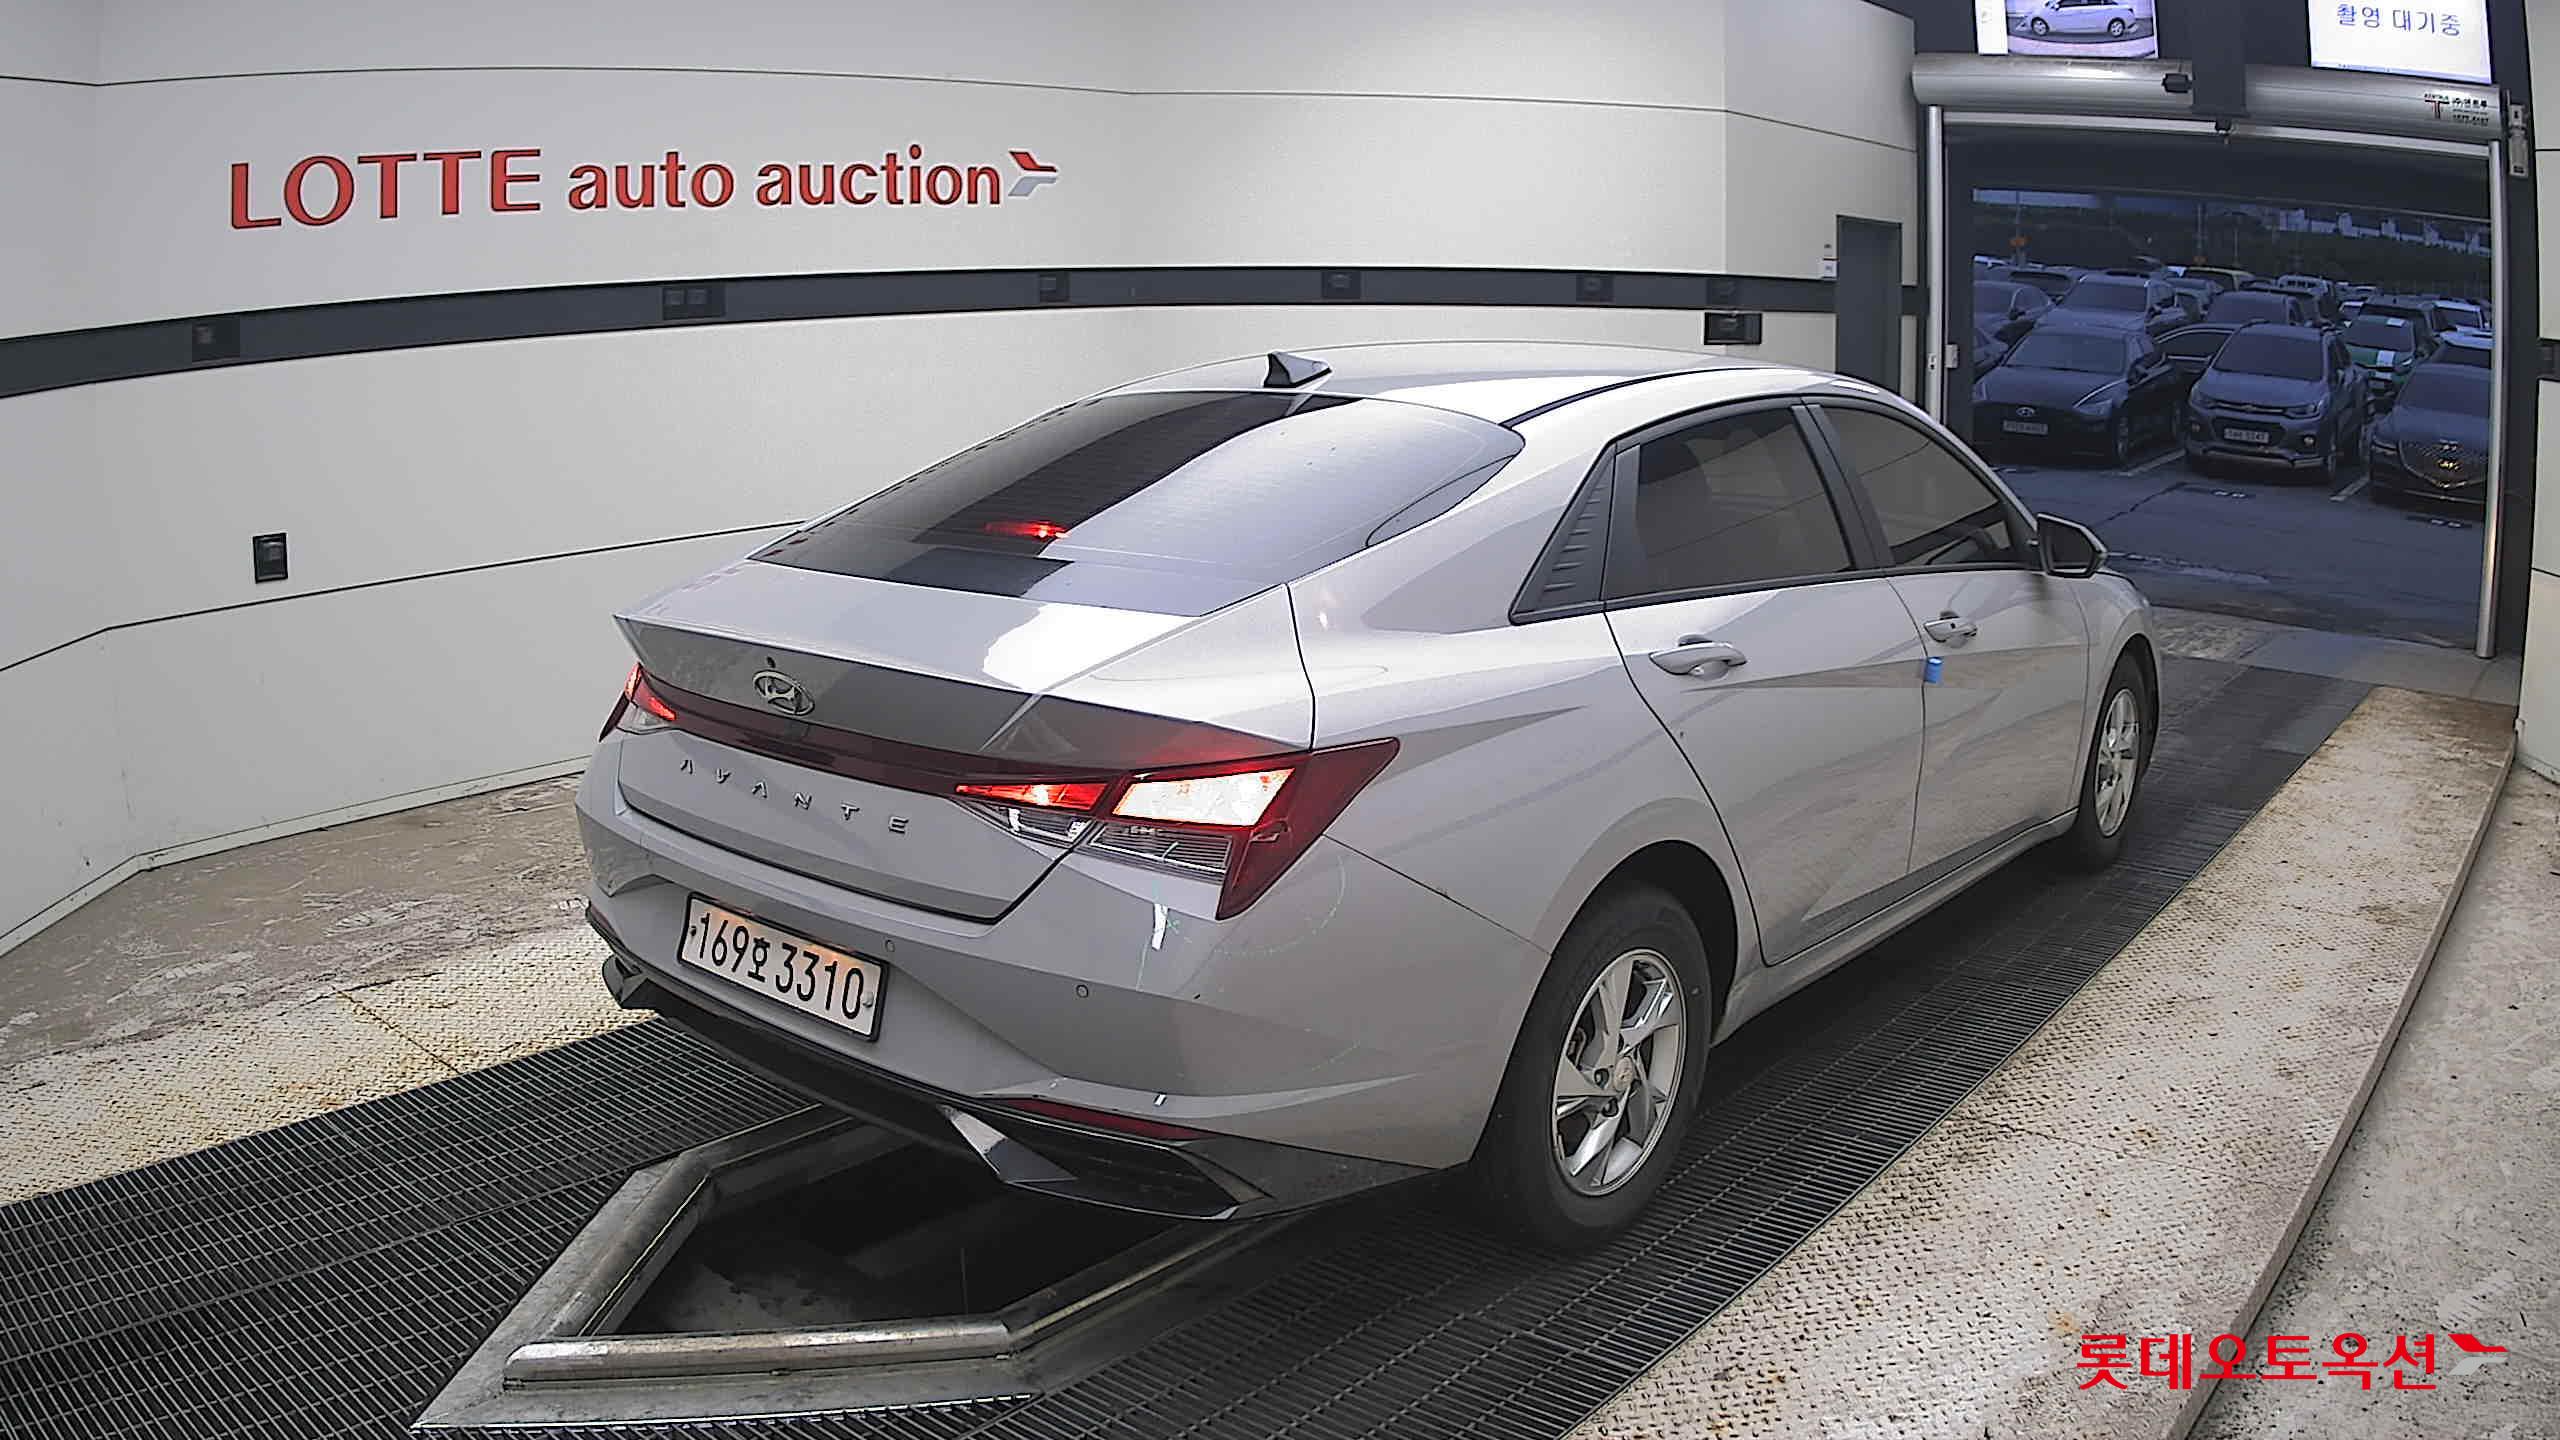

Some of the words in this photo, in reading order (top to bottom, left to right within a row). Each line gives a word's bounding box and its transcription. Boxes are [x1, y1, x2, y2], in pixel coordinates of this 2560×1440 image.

[2337, 3, 2380, 28] 촬영
[2392, 9, 2460, 36] 대기중
[231, 149, 541, 229] LOTTE
[568, 150, 734, 210] auto
[755, 144, 1001, 206] auction
[680, 758, 909, 834] AVANTE
